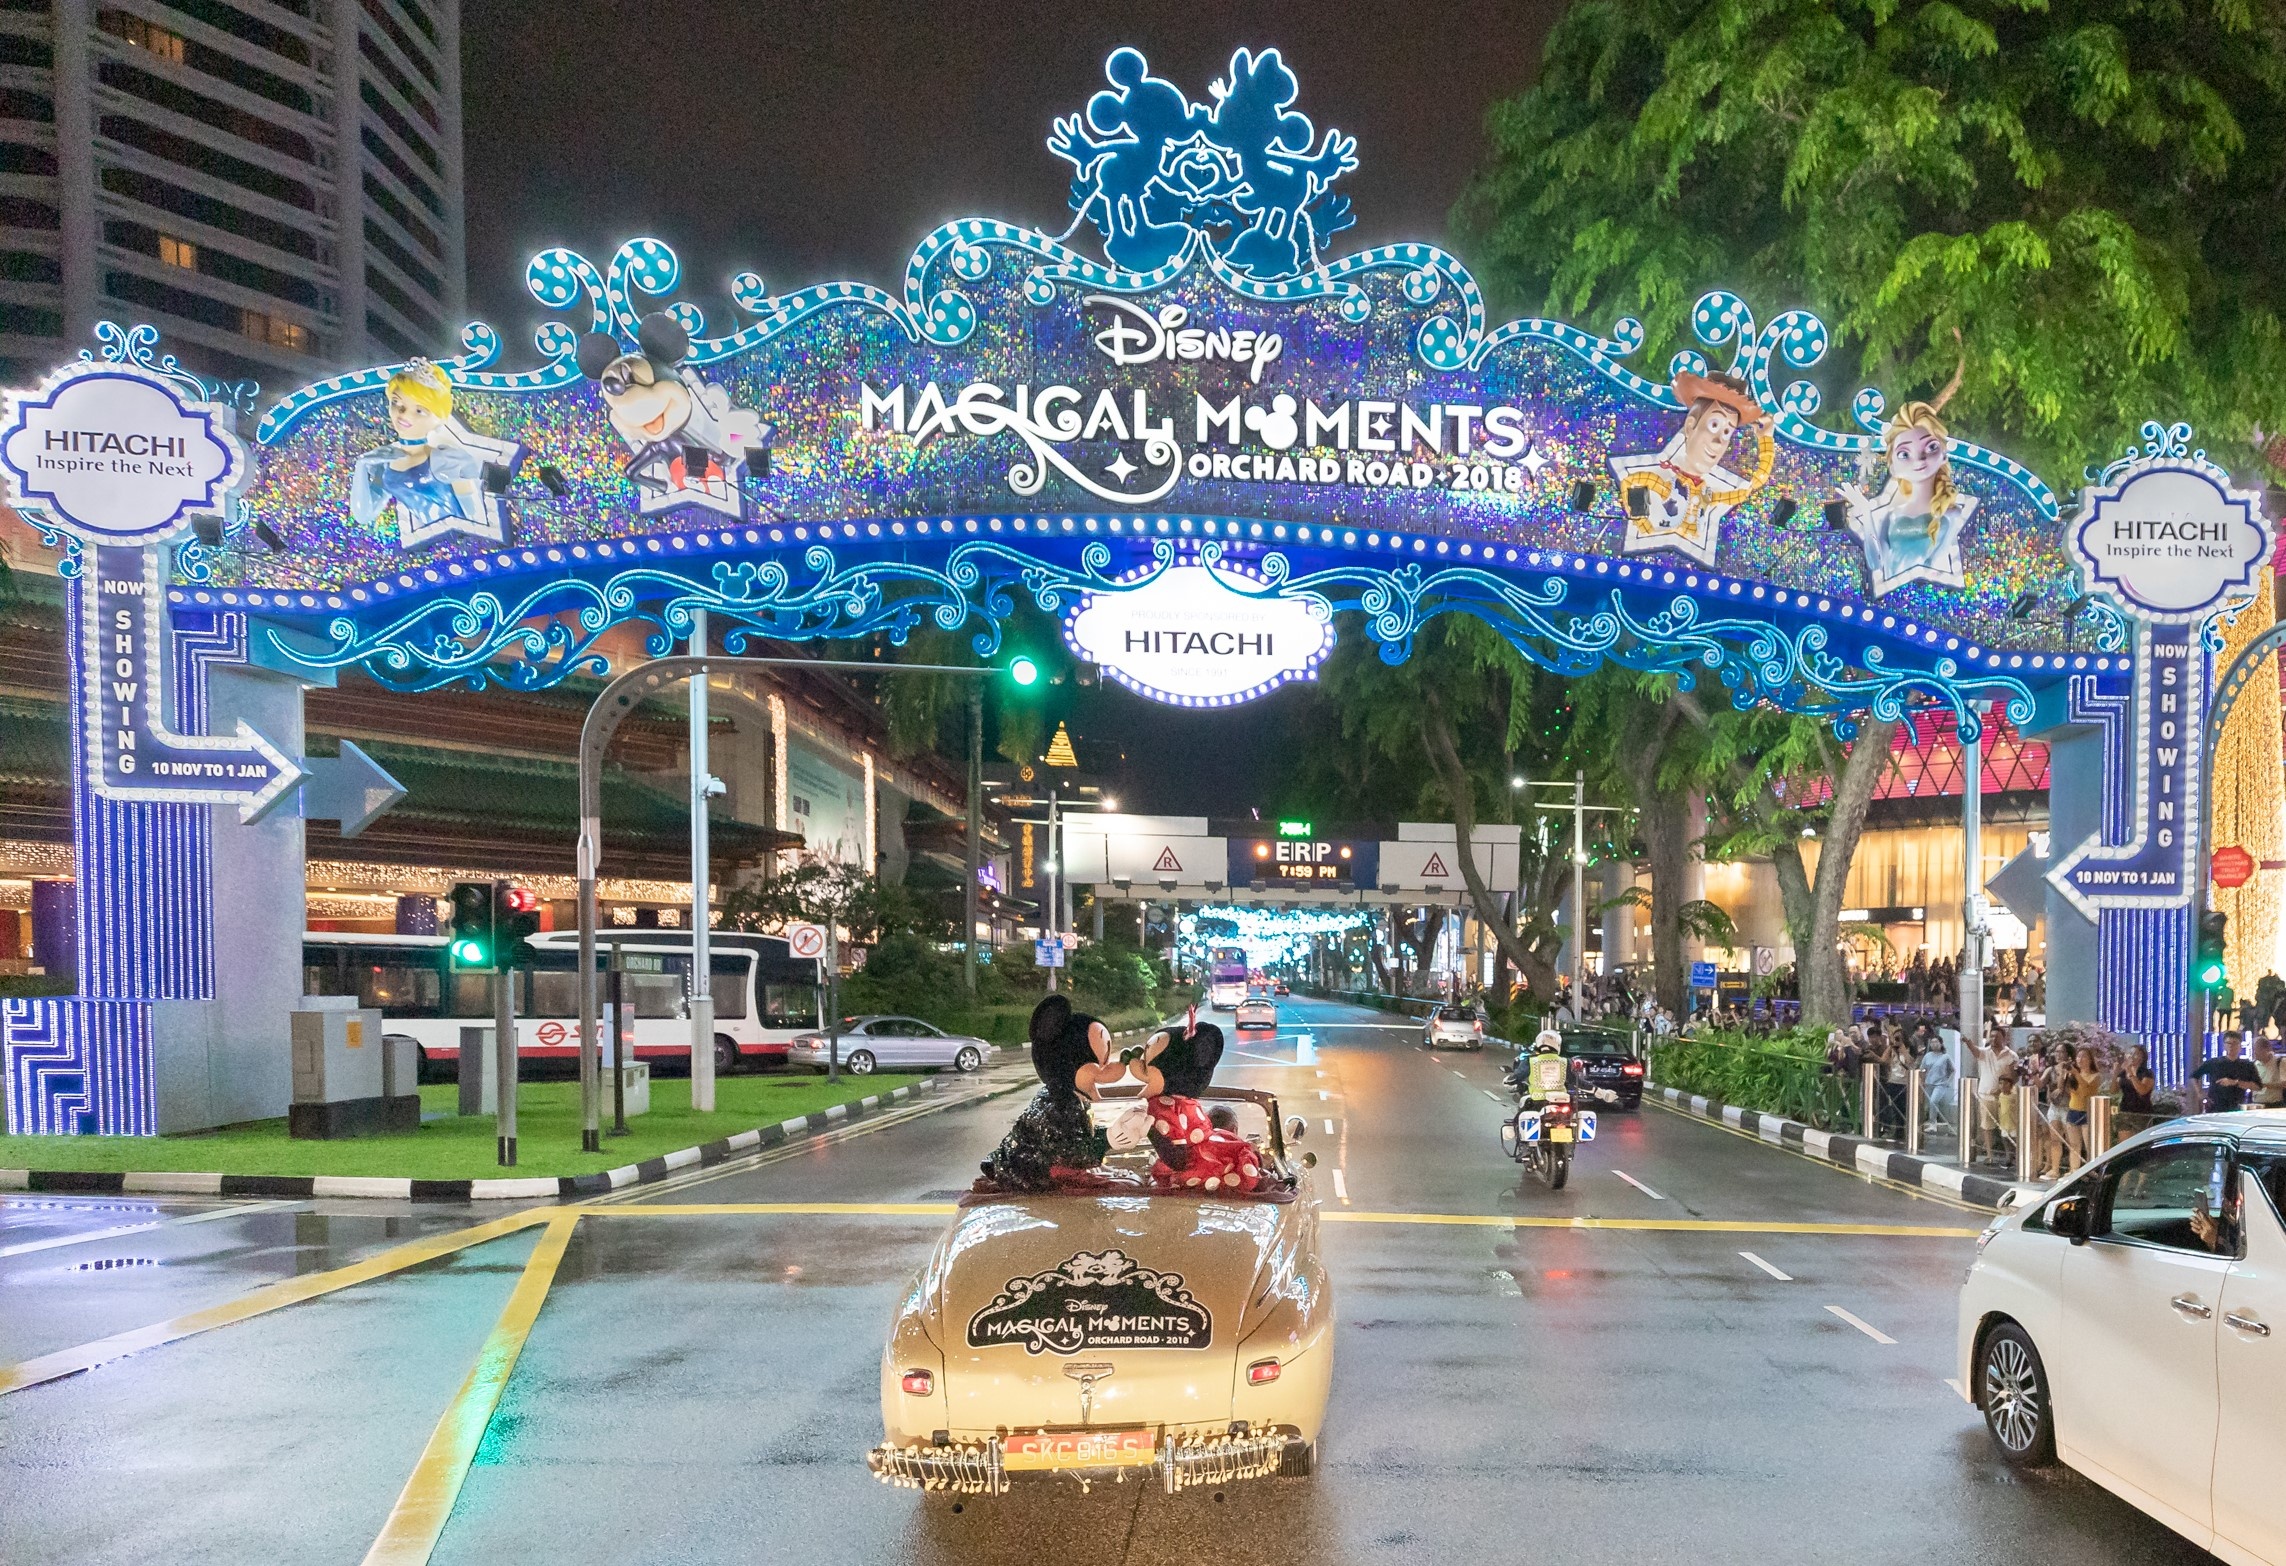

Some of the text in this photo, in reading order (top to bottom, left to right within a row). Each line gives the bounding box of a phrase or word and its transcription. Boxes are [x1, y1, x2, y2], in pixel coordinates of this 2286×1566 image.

[45, 430, 186, 458] HITACHI
[36, 455, 194, 477] Inspire the Next
[1188, 453, 1522, 490] ORCHARD ROAD 2018
[2114, 521, 2228, 541] HITACHI
[2107, 544, 2234, 559] Inspire the Next
[104, 580, 145, 595] NOW
[1131, 610, 1266, 622] PROUDLY SPONSORED BY
[1125, 630, 1273, 656] HITACHI
[2154, 644, 2188, 659] NOW
[1170, 667, 1201, 677] SINCE
[112, 610, 137, 774] SHOWING
[2156, 667, 2178, 847] SHOWING
[152, 762, 268, 778] 10 NOV TO 1 JAN
[1164, 857, 1172, 868] R
[1431, 863, 1439, 873] R
[1279, 865, 1337, 878] 7:59 PM
[2076, 870, 2176, 884] 10 NOV TO 1 JAN
[987, 1317, 1084, 1351] MAGICAL
[1088, 1336, 1132, 1344] ORCHARD
[1166, 1337, 1189, 1345] 2018
